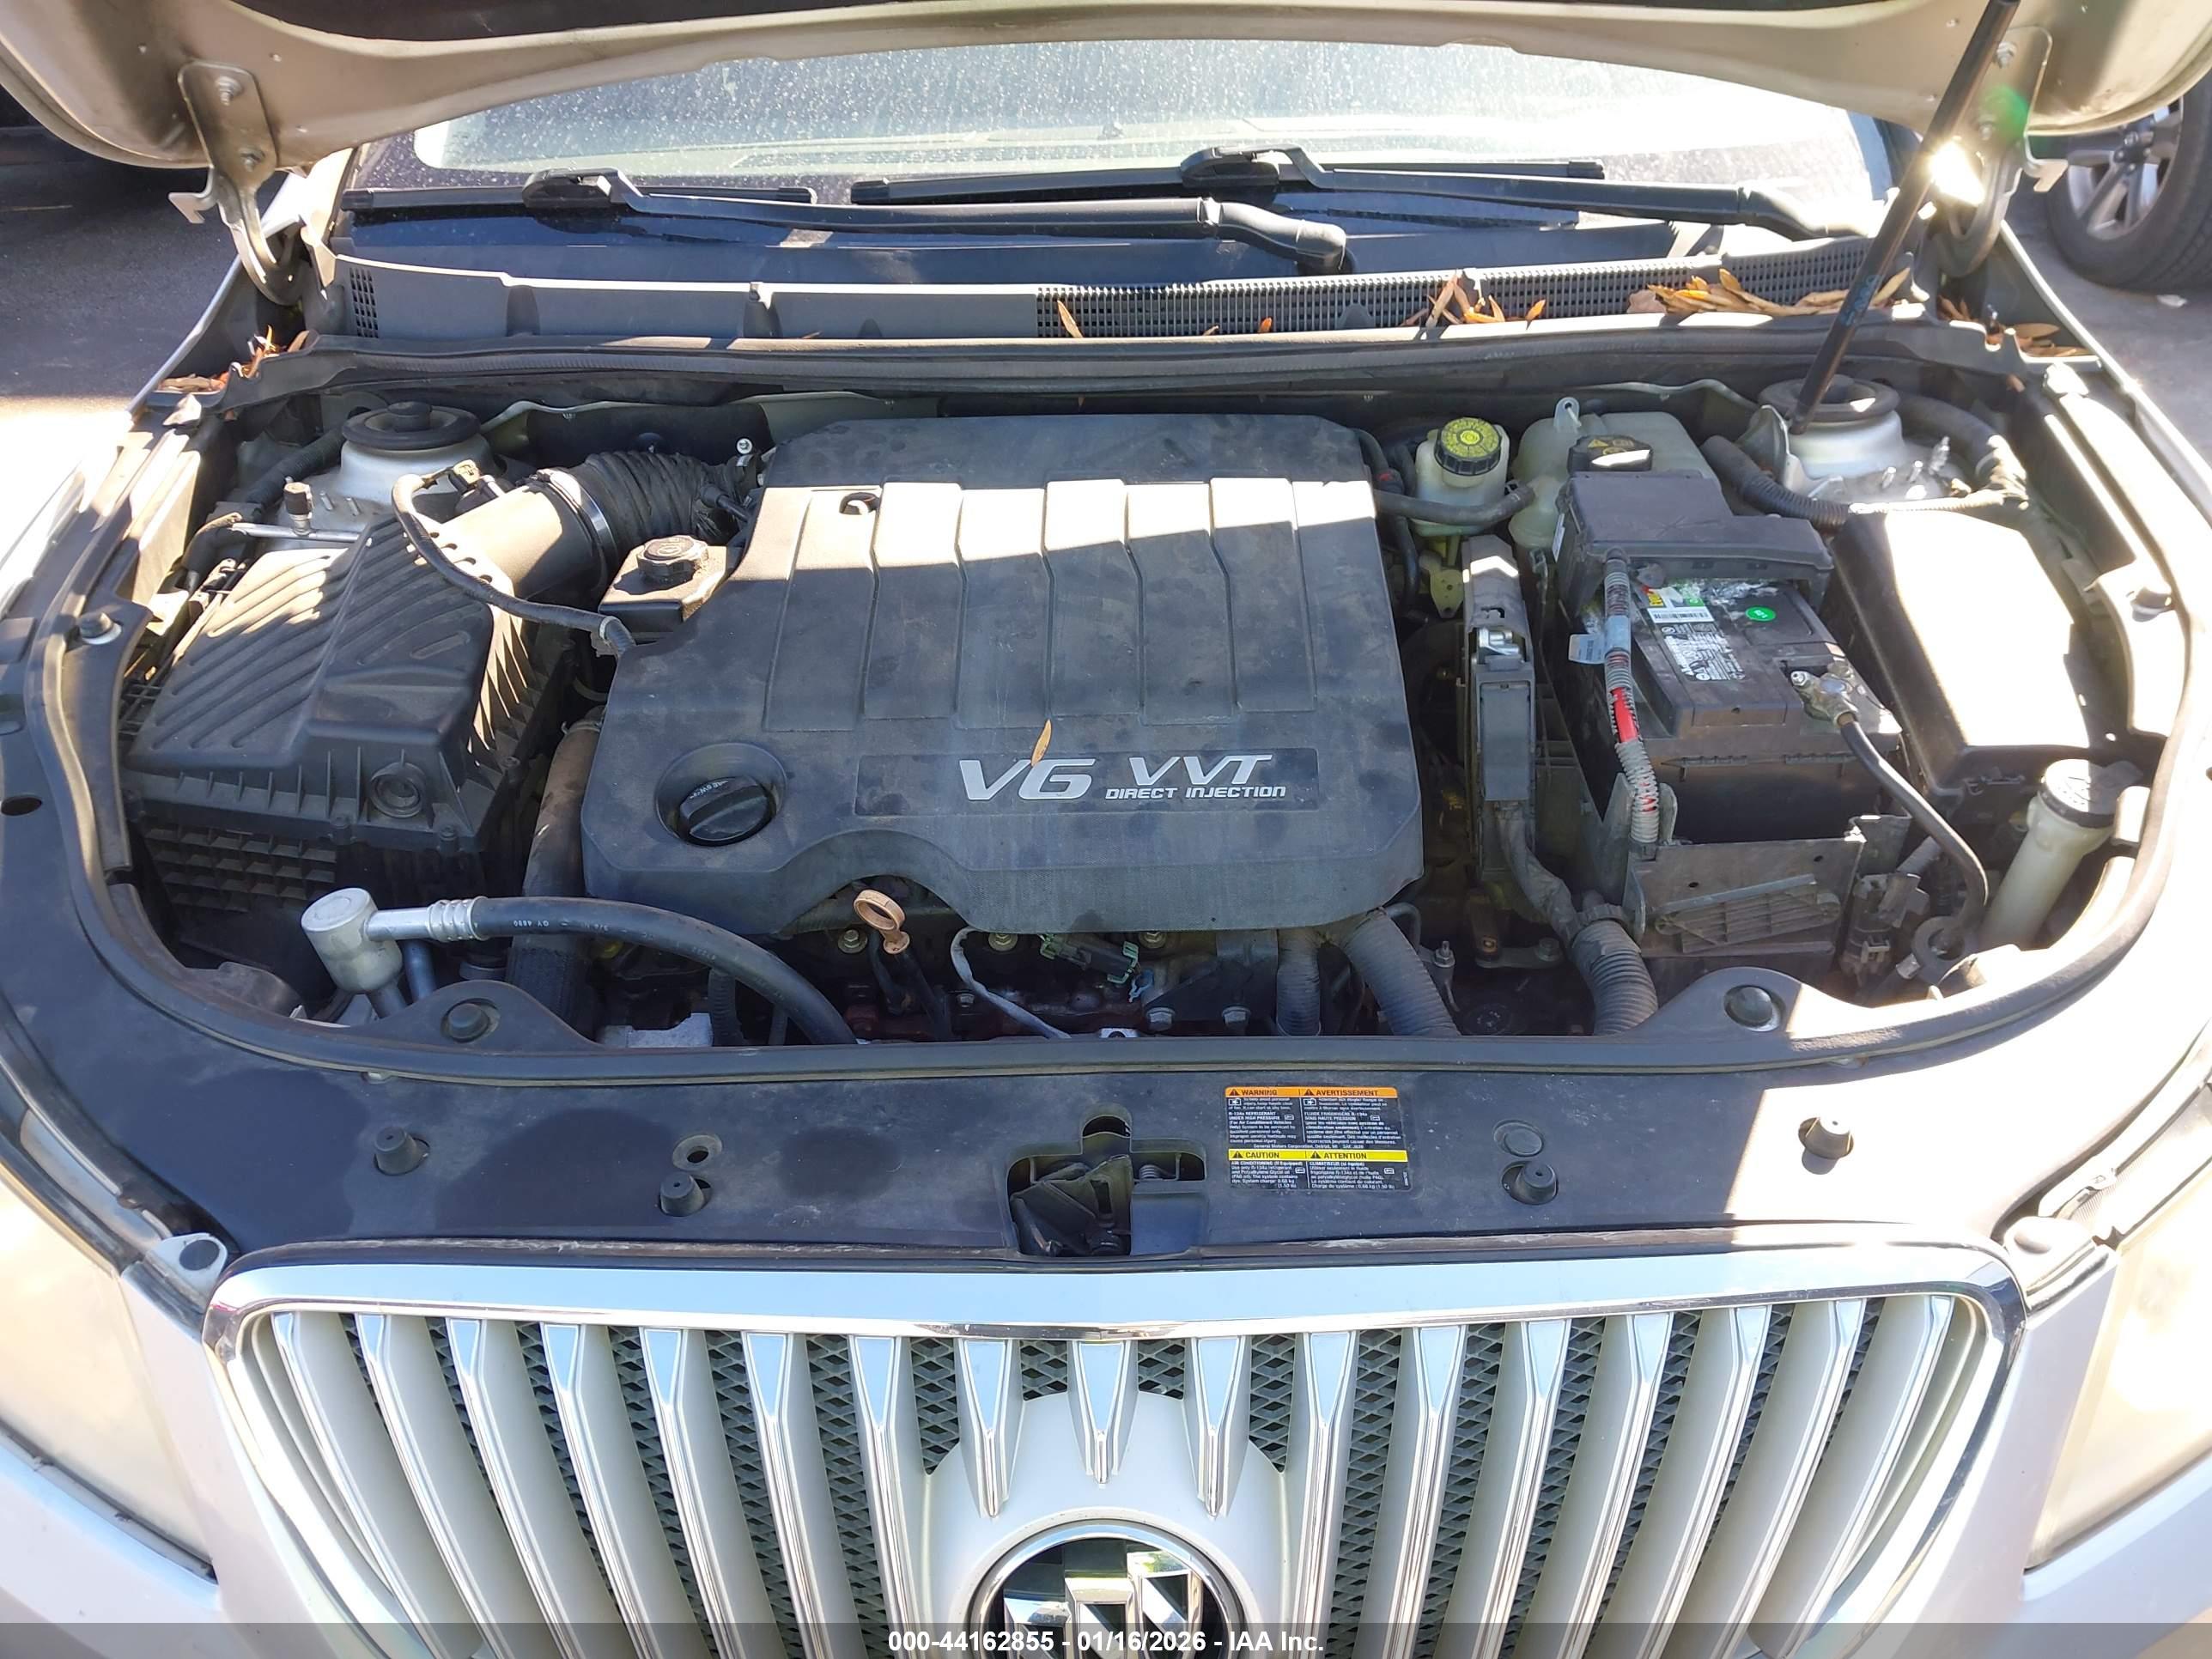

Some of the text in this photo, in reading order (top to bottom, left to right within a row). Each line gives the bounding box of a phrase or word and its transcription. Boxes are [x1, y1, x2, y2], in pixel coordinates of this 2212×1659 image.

[958, 754, 1273, 801] V6 VVT
[1105, 786, 1286, 799] DIRECT INJECTION
